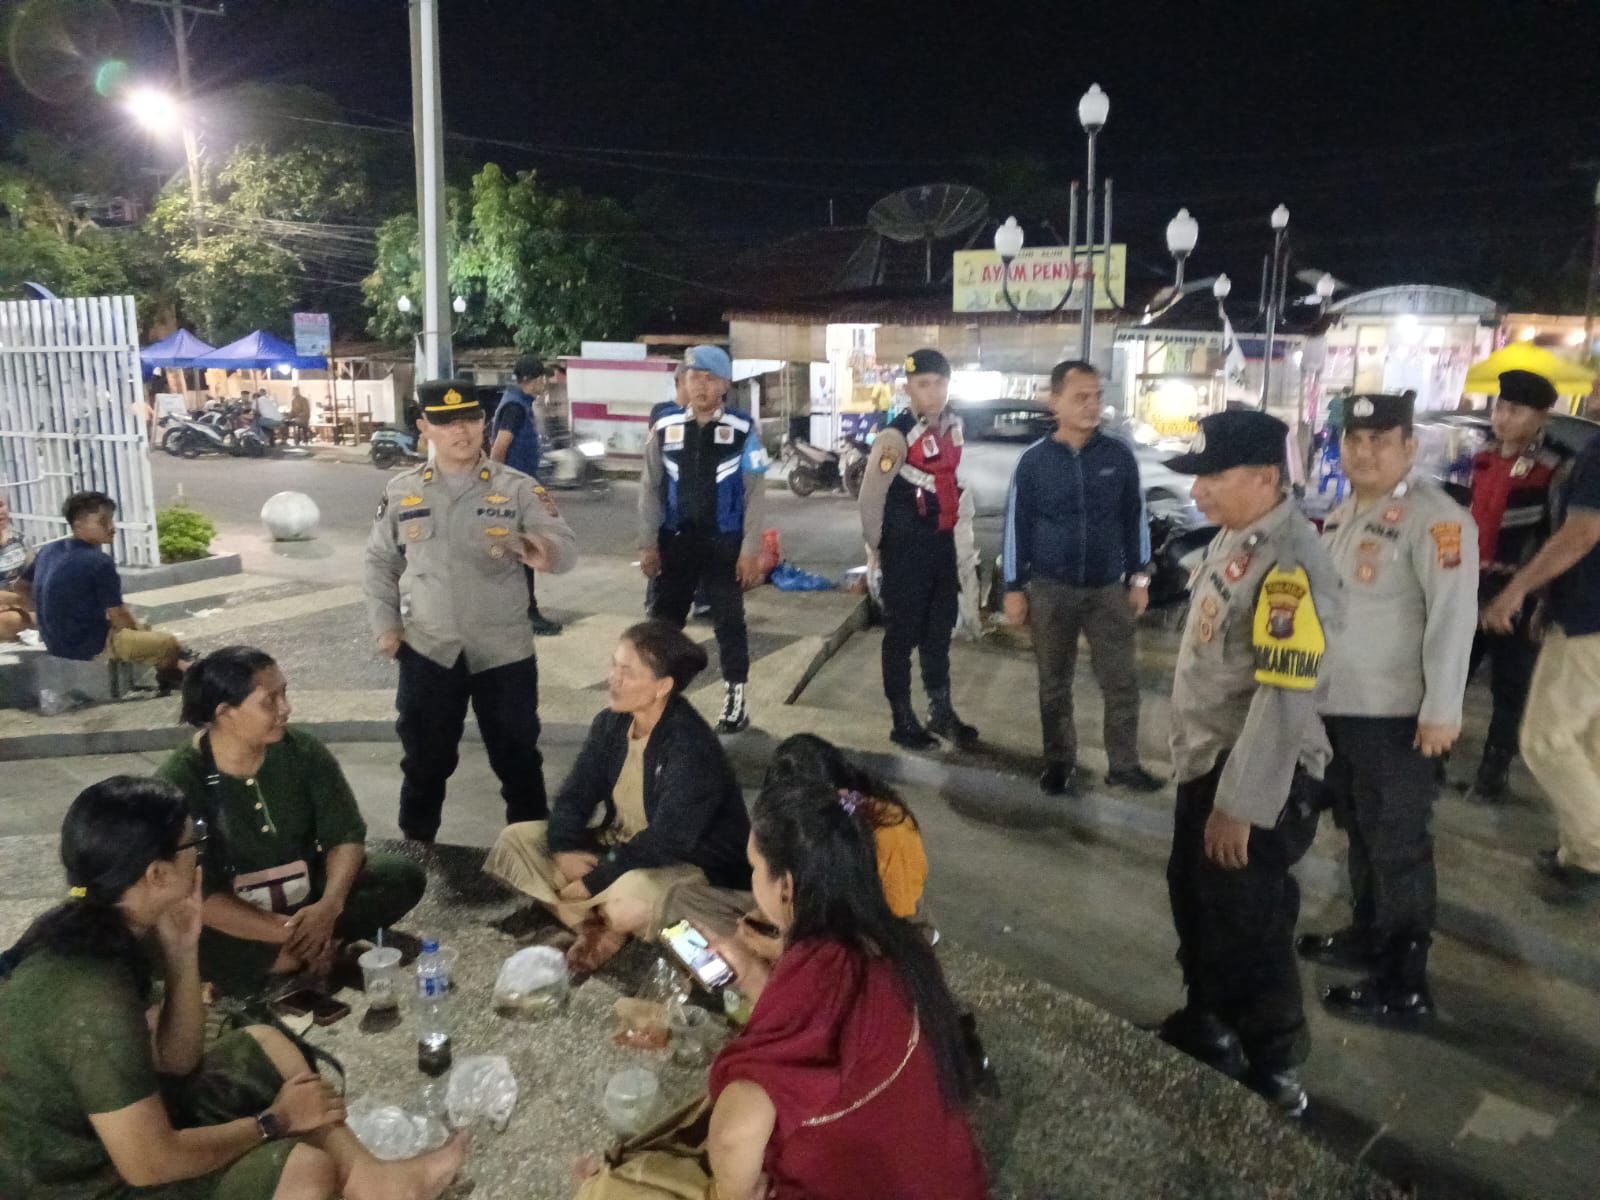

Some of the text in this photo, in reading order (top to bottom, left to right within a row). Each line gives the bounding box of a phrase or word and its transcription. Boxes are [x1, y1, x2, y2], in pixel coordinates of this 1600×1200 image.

[982, 259, 1095, 282] AYAM PENYE
[476, 508, 517, 519] POLRI
